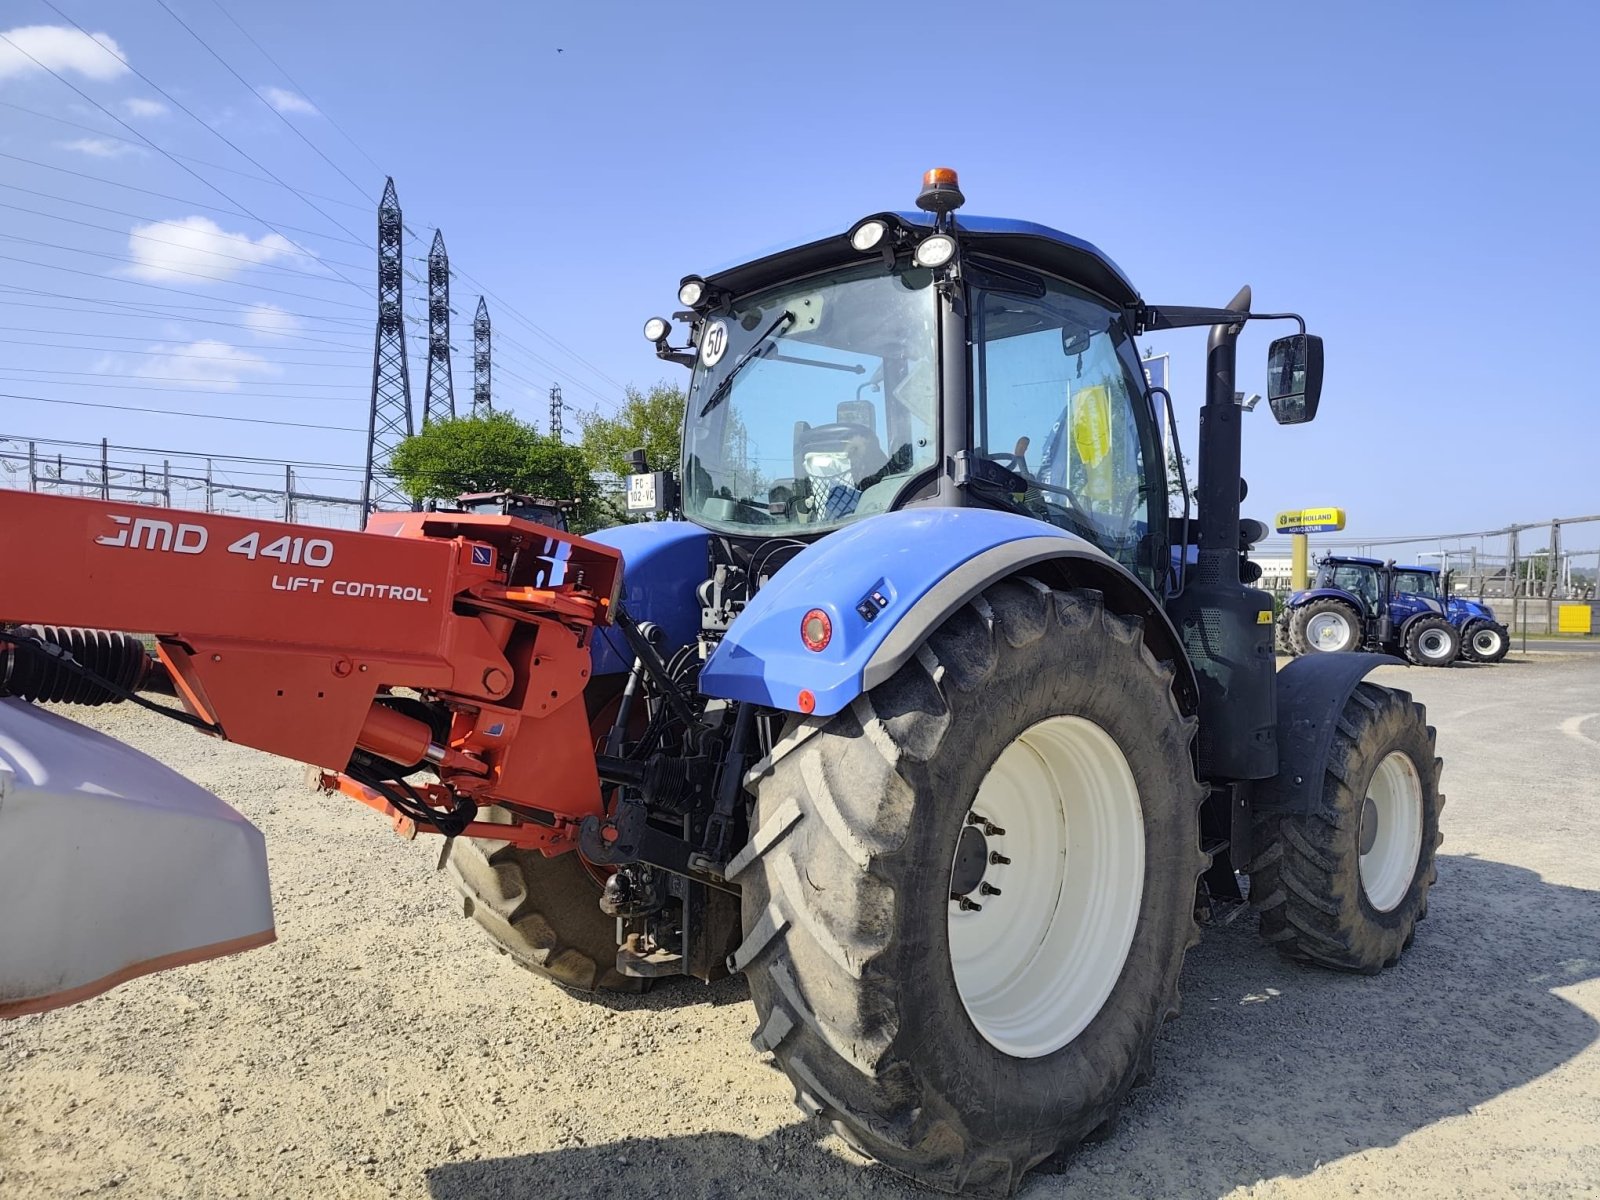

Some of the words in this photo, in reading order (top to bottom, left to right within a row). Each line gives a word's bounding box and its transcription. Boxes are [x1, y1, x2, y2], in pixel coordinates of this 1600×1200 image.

[706, 327, 724, 358] 50
[1303, 513, 1332, 522] HOLLAND
[227, 531, 334, 567] 4410
[271, 575, 325, 593] LIFT
[331, 581, 429, 601] CONTROL
